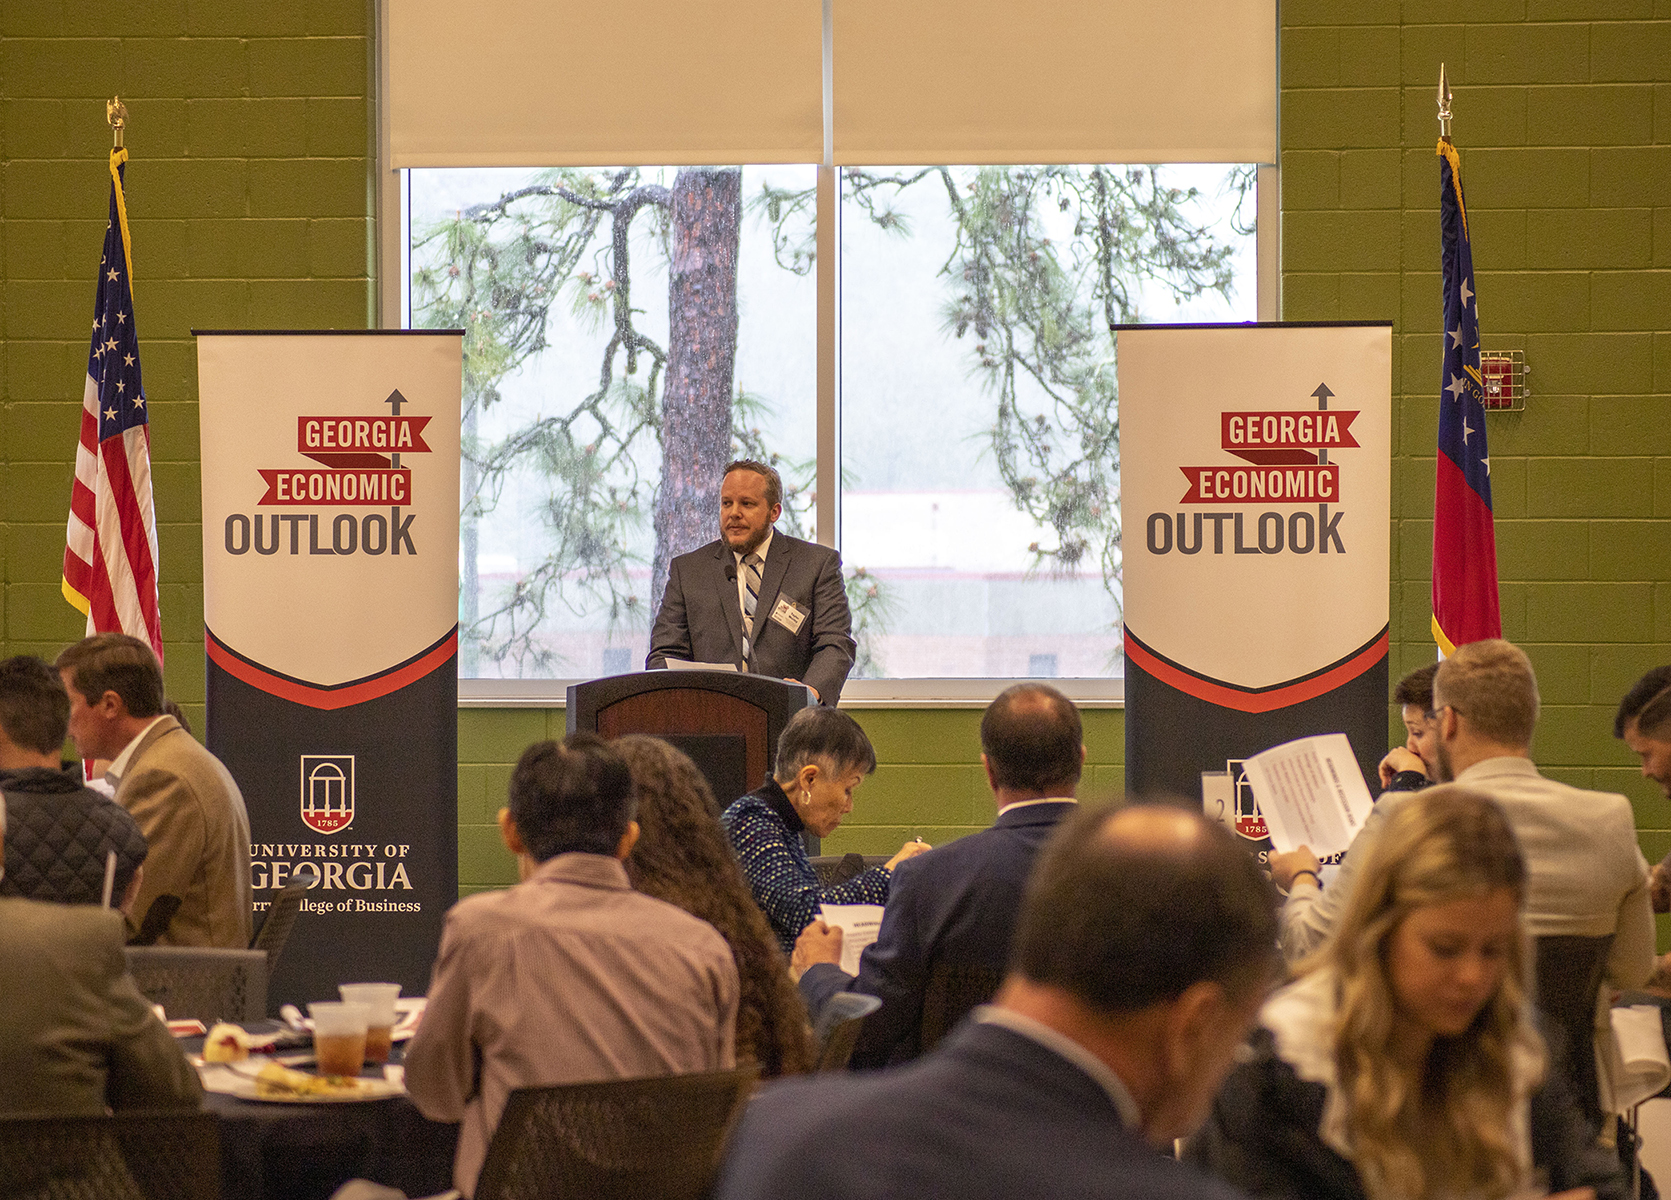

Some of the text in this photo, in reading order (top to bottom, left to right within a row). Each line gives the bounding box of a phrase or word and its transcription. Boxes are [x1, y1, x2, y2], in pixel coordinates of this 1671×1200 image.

[1472, 389, 1485, 407] GO
[305, 420, 413, 448] GEORGIA
[1229, 415, 1341, 444] GEORGIA
[276, 473, 405, 501] ECONOMIC
[1199, 469, 1333, 498] ECONOMIC
[224, 506, 418, 556] OUTLOOK
[1146, 503, 1347, 556] OUTLOOK
[316, 819, 339, 827] 1785
[1216, 798, 1225, 822] 2
[1245, 825, 1267, 833] 1785
[249, 843, 410, 858] UNIVERSITY OF
[299, 898, 421, 915] llege of Business
